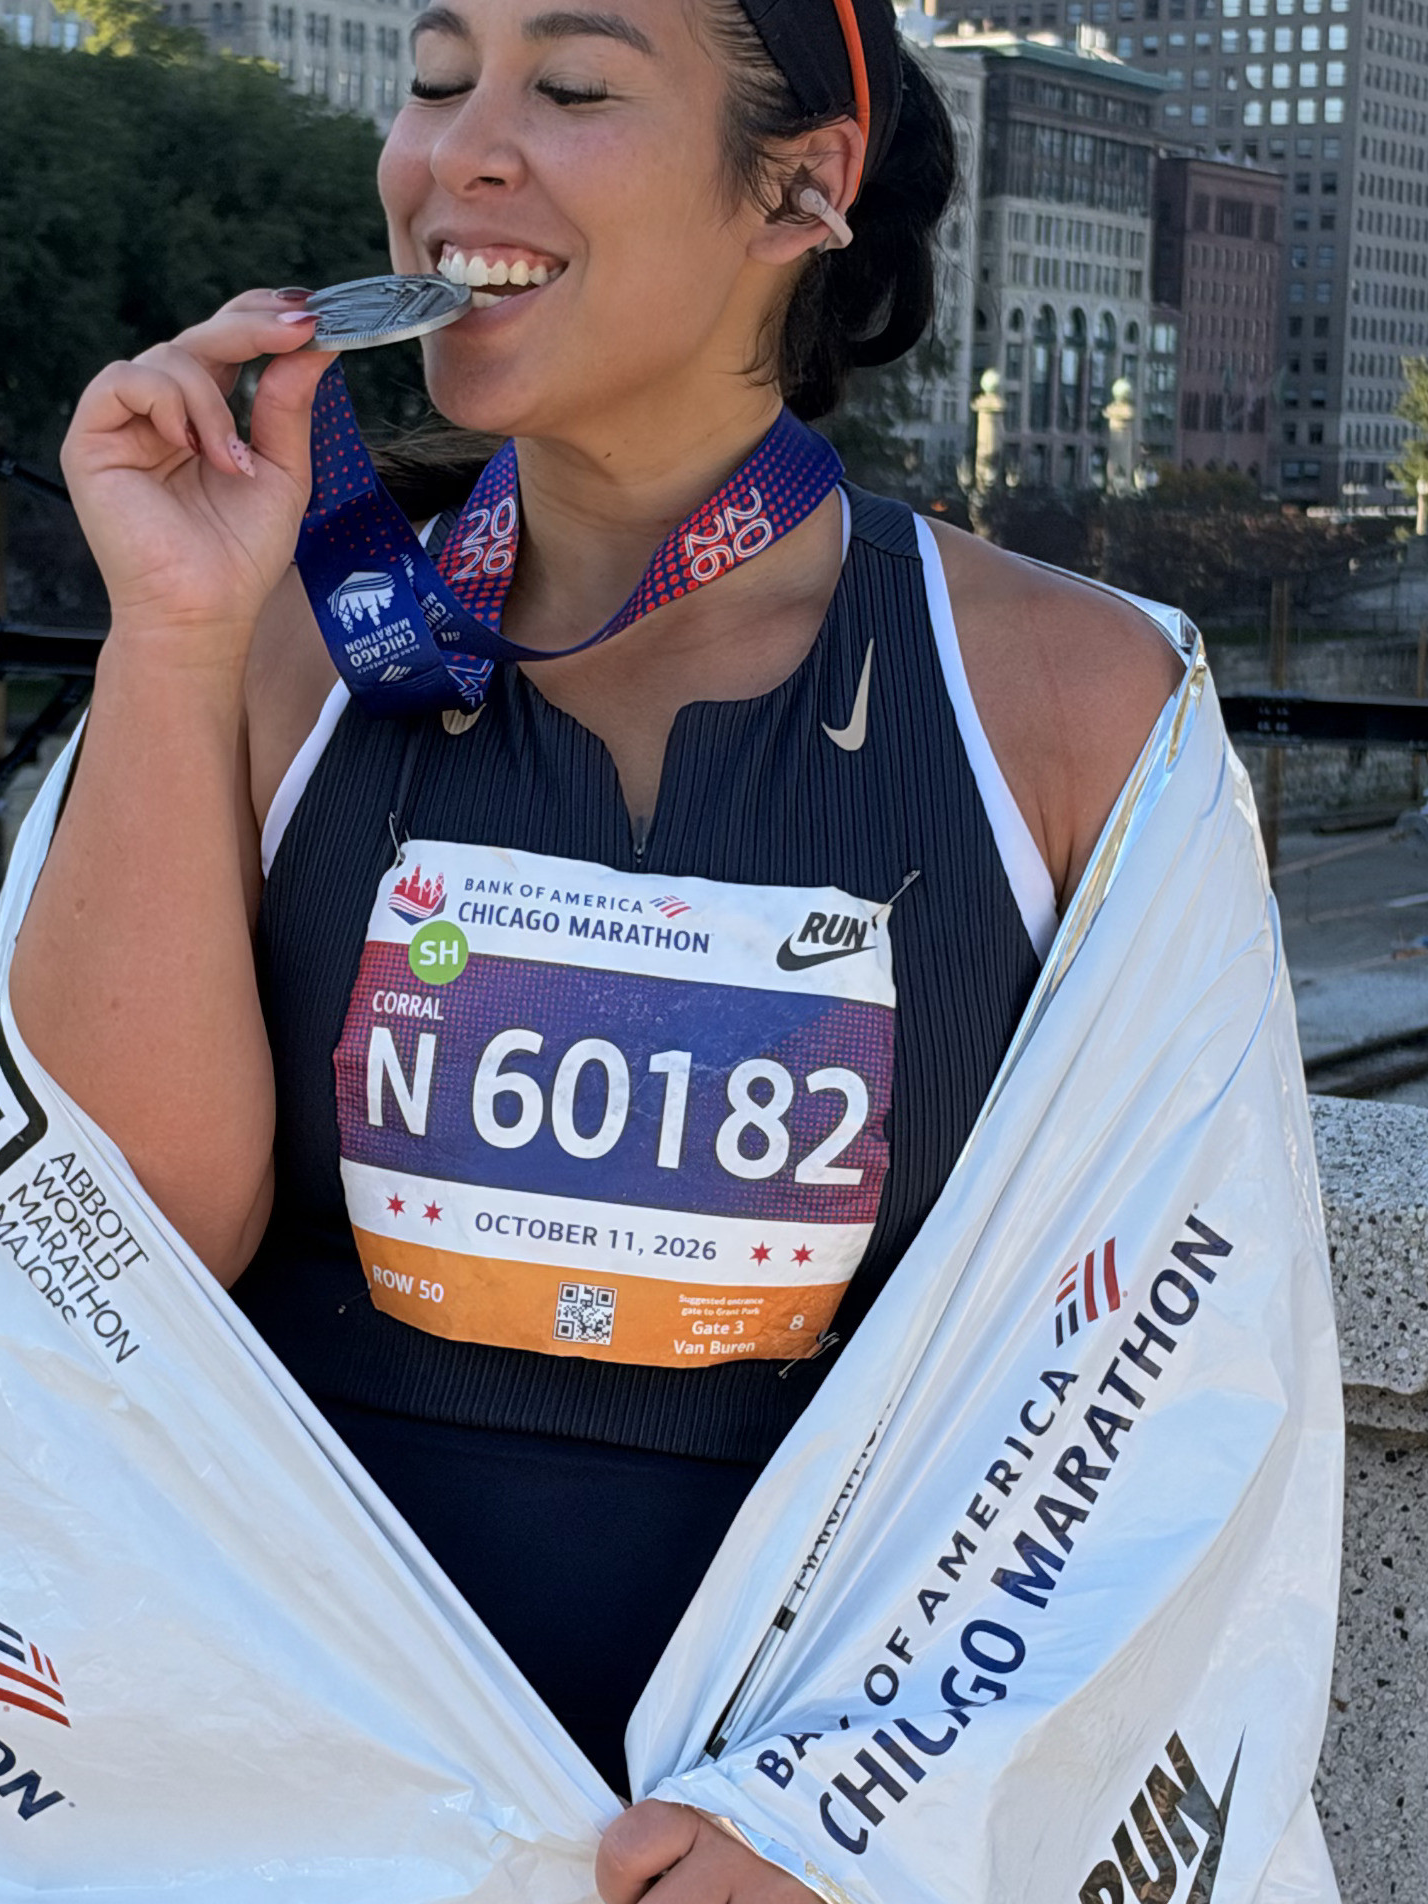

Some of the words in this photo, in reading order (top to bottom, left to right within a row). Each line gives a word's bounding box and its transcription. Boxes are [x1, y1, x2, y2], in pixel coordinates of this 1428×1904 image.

[462, 496, 516, 548] 20
[724, 486, 773, 558] 20
[451, 536, 512, 581] 26
[685, 514, 734, 581] 26
[344, 617, 411, 654] MARATHON
[350, 629, 416, 667] CHICAGO
[464, 878, 513, 896] BANK
[520, 884, 546, 899] OF
[550, 890, 643, 914] AMERICA
[458, 901, 560, 933] CHICAGO
[568, 916, 710, 954] MARATHON
[797, 911, 868, 949] RUN
[419, 940, 459, 965] SH
[373, 990, 444, 1020] CORRAL
[367, 1026, 437, 1137] N
[472, 1028, 870, 1186] 60182
[32, 1162, 121, 1281] WORLD
[49, 1152, 150, 1268] ABBOTT
[475, 1212, 598, 1247] OCTOBER
[608, 1229, 644, 1256] 11,
[653, 1235, 718, 1261] 2026
[8, 1183, 140, 1364] MARATHON
[372, 1264, 414, 1295] ROW
[419, 1280, 445, 1303] 50
[678, 1294, 726, 1306] Suggested
[727, 1298, 765, 1306] entrance
[681, 1307, 702, 1316] gate
[704, 1308, 715, 1316] to
[716, 1307, 740, 1316] Grant
[741, 1307, 760, 1315] Park
[691, 1320, 730, 1335] Gate
[733, 1320, 745, 1335] 3
[789, 1314, 804, 1331] 8
[673, 1339, 705, 1355] Van
[709, 1340, 756, 1355] Buren
[819, 1618, 1026, 1855] CHICGO
[990, 1213, 1234, 1610] MARATHON
[863, 1626, 918, 1707] OF
[917, 1367, 1079, 1626] AMERICA
